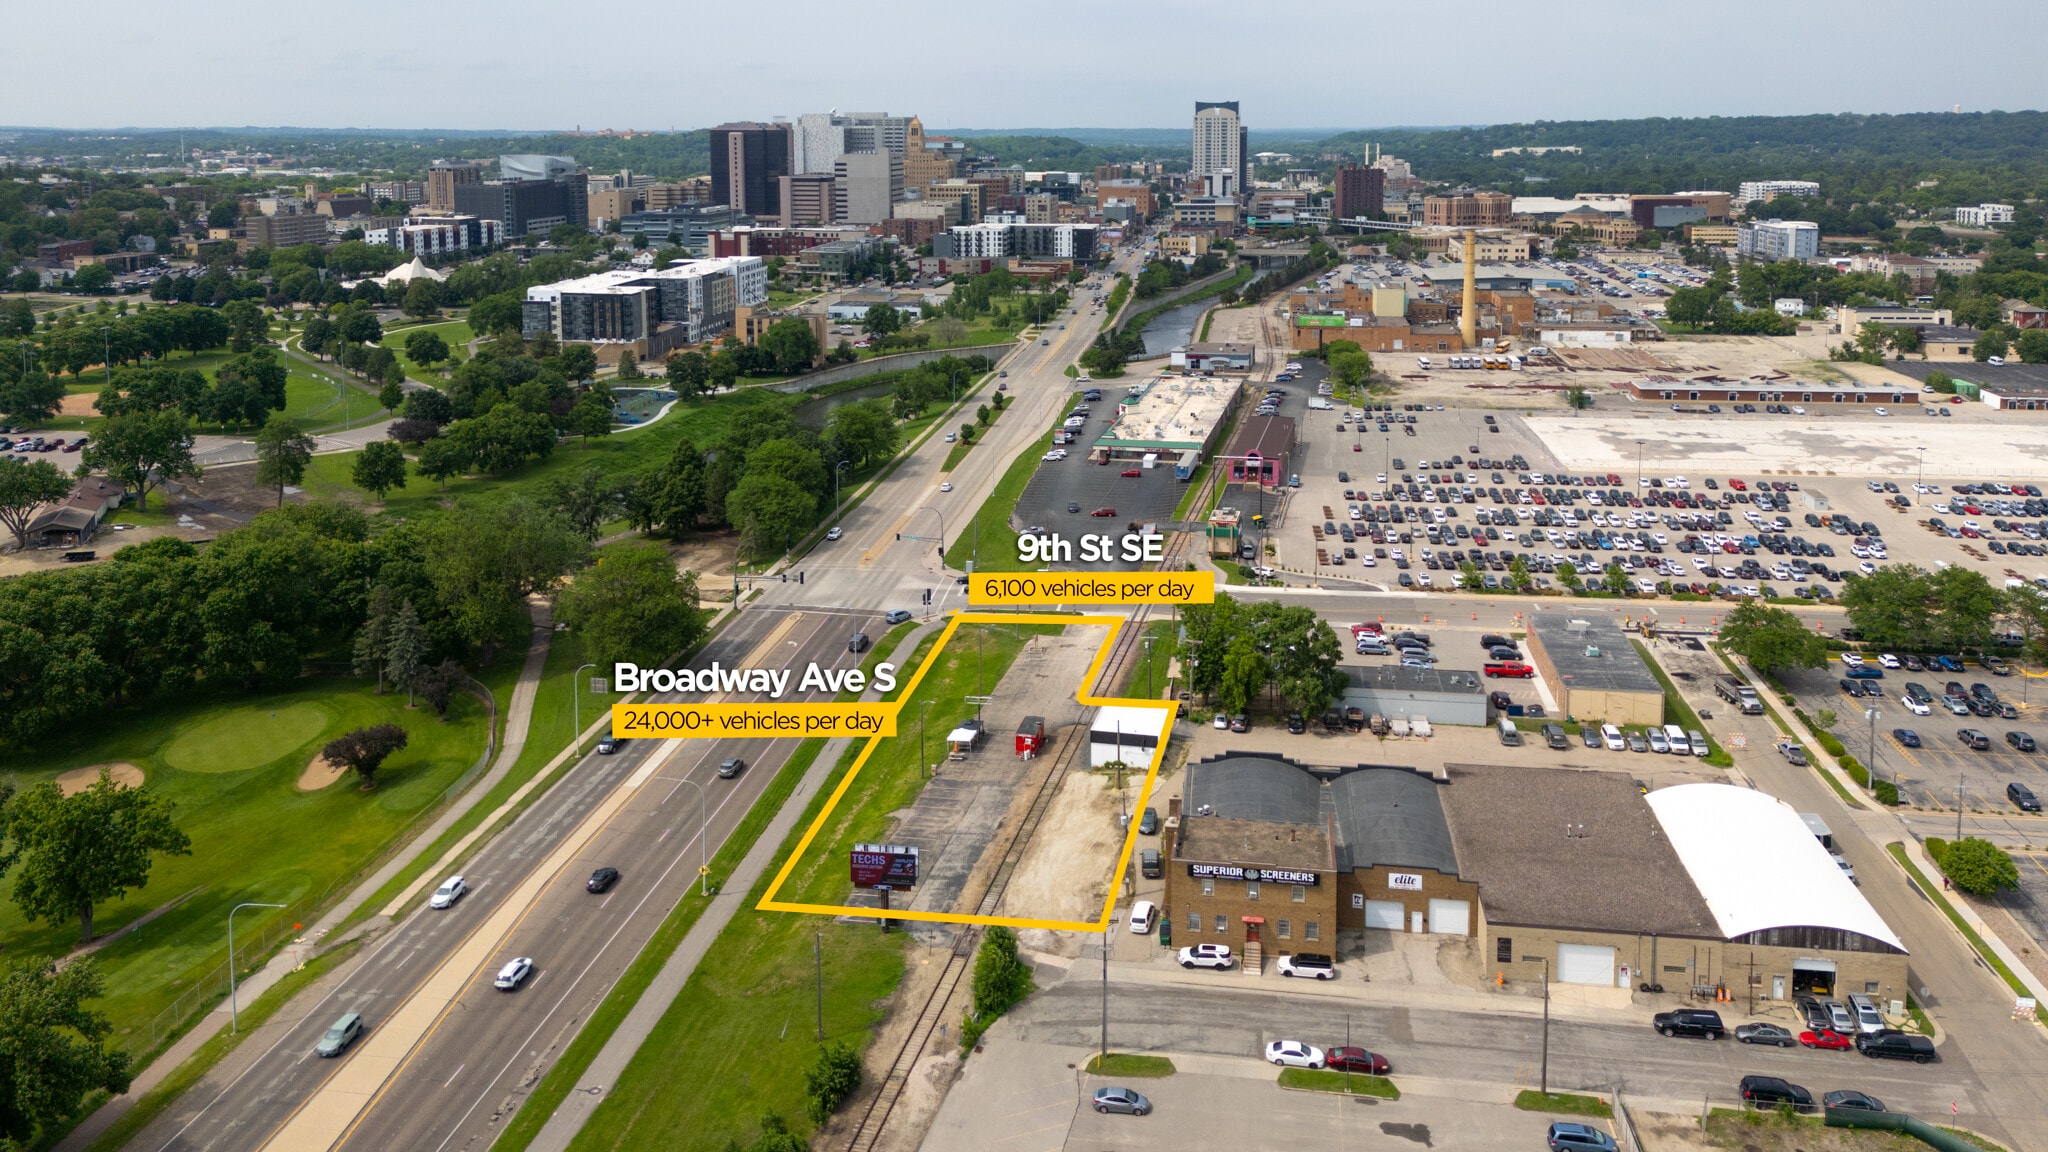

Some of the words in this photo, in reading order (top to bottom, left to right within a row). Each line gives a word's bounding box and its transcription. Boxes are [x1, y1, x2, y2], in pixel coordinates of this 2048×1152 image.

[852, 854, 886, 865] TECHS
[1193, 864, 1243, 876] SUPERIOR
[1260, 869, 1315, 882] SCREENERS
